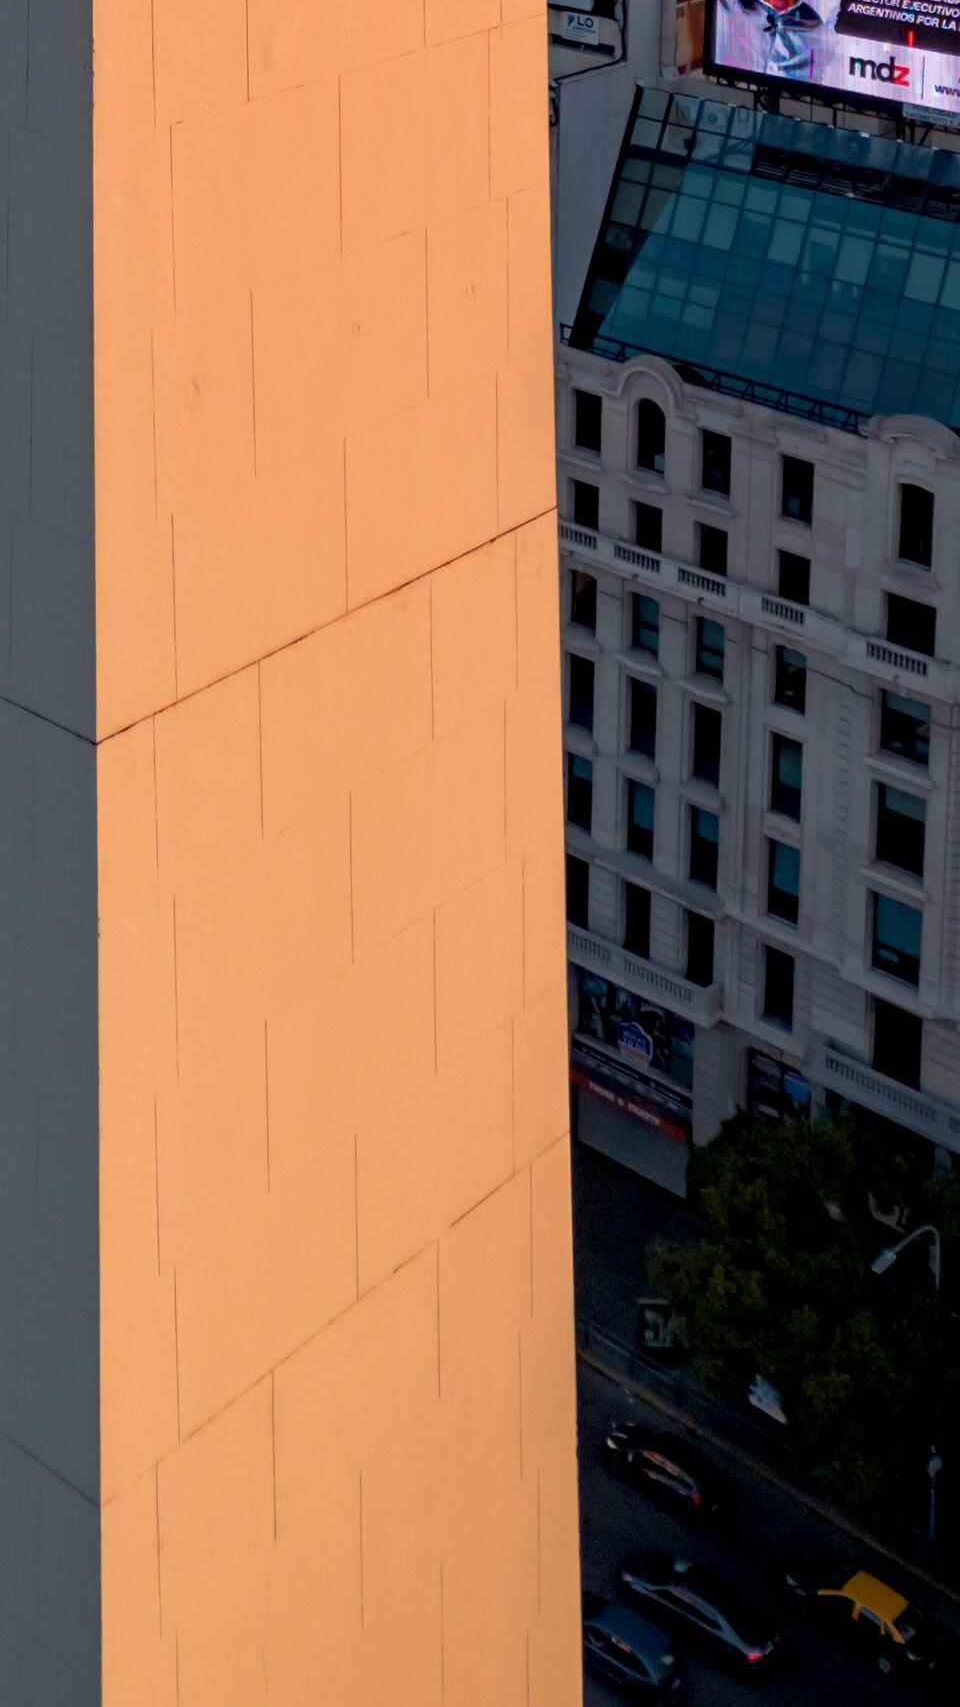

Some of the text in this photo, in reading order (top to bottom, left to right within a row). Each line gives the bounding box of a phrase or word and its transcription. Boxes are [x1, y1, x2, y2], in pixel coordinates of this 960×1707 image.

[848, 3, 956, 31] ARGENTINOS POR LA
[902, 0, 960, 18] EJECUTIVO
[849, 56, 910, 87] mdz
